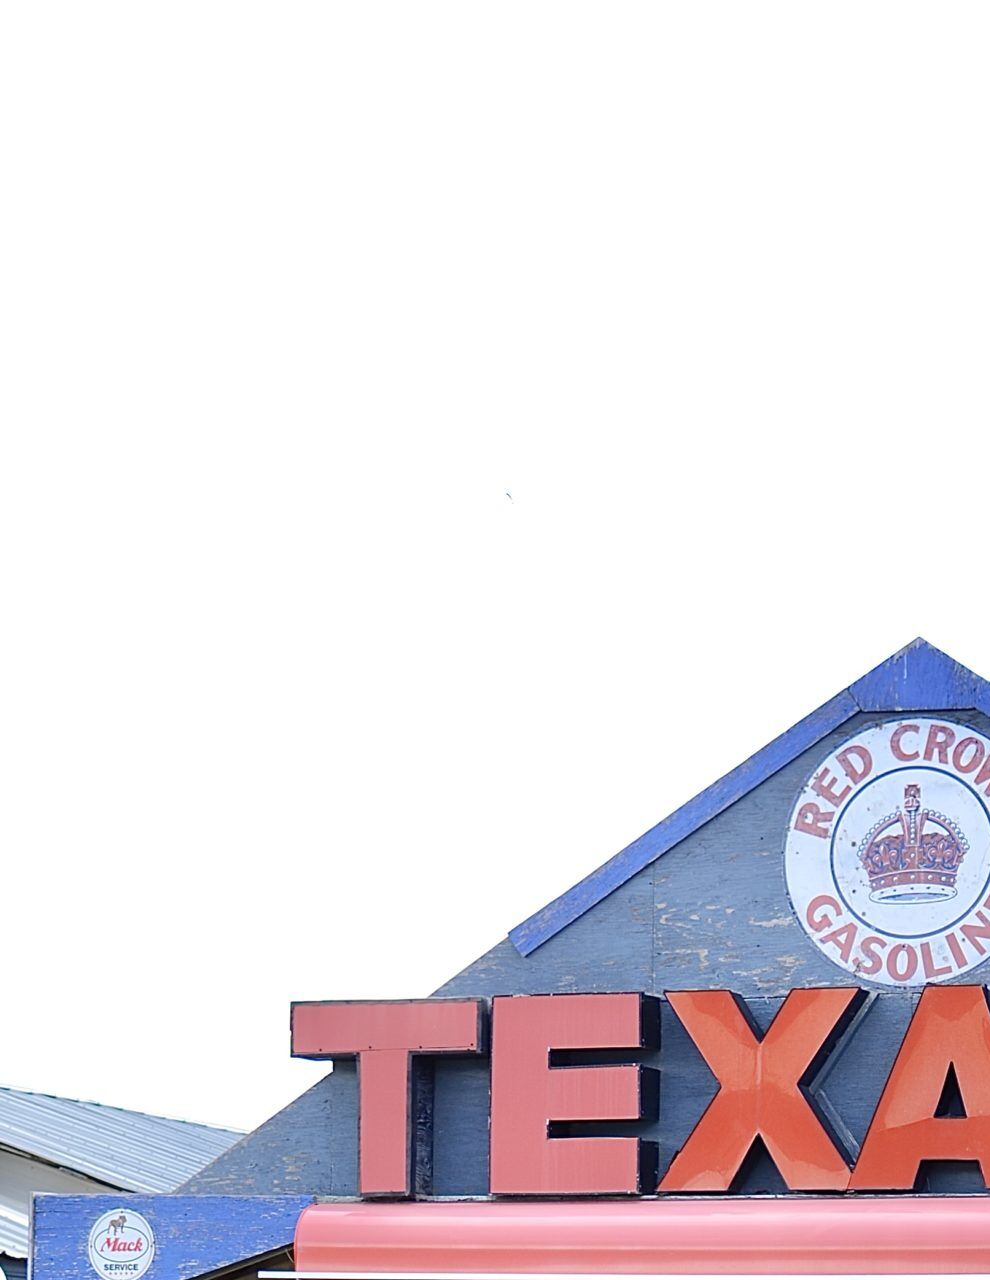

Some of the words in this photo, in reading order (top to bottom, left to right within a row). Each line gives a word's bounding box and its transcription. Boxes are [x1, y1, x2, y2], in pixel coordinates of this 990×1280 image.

[793, 744, 873, 839] RED
[100, 1237, 143, 1252] Mack
[104, 1263, 139, 1271] SERVICE
